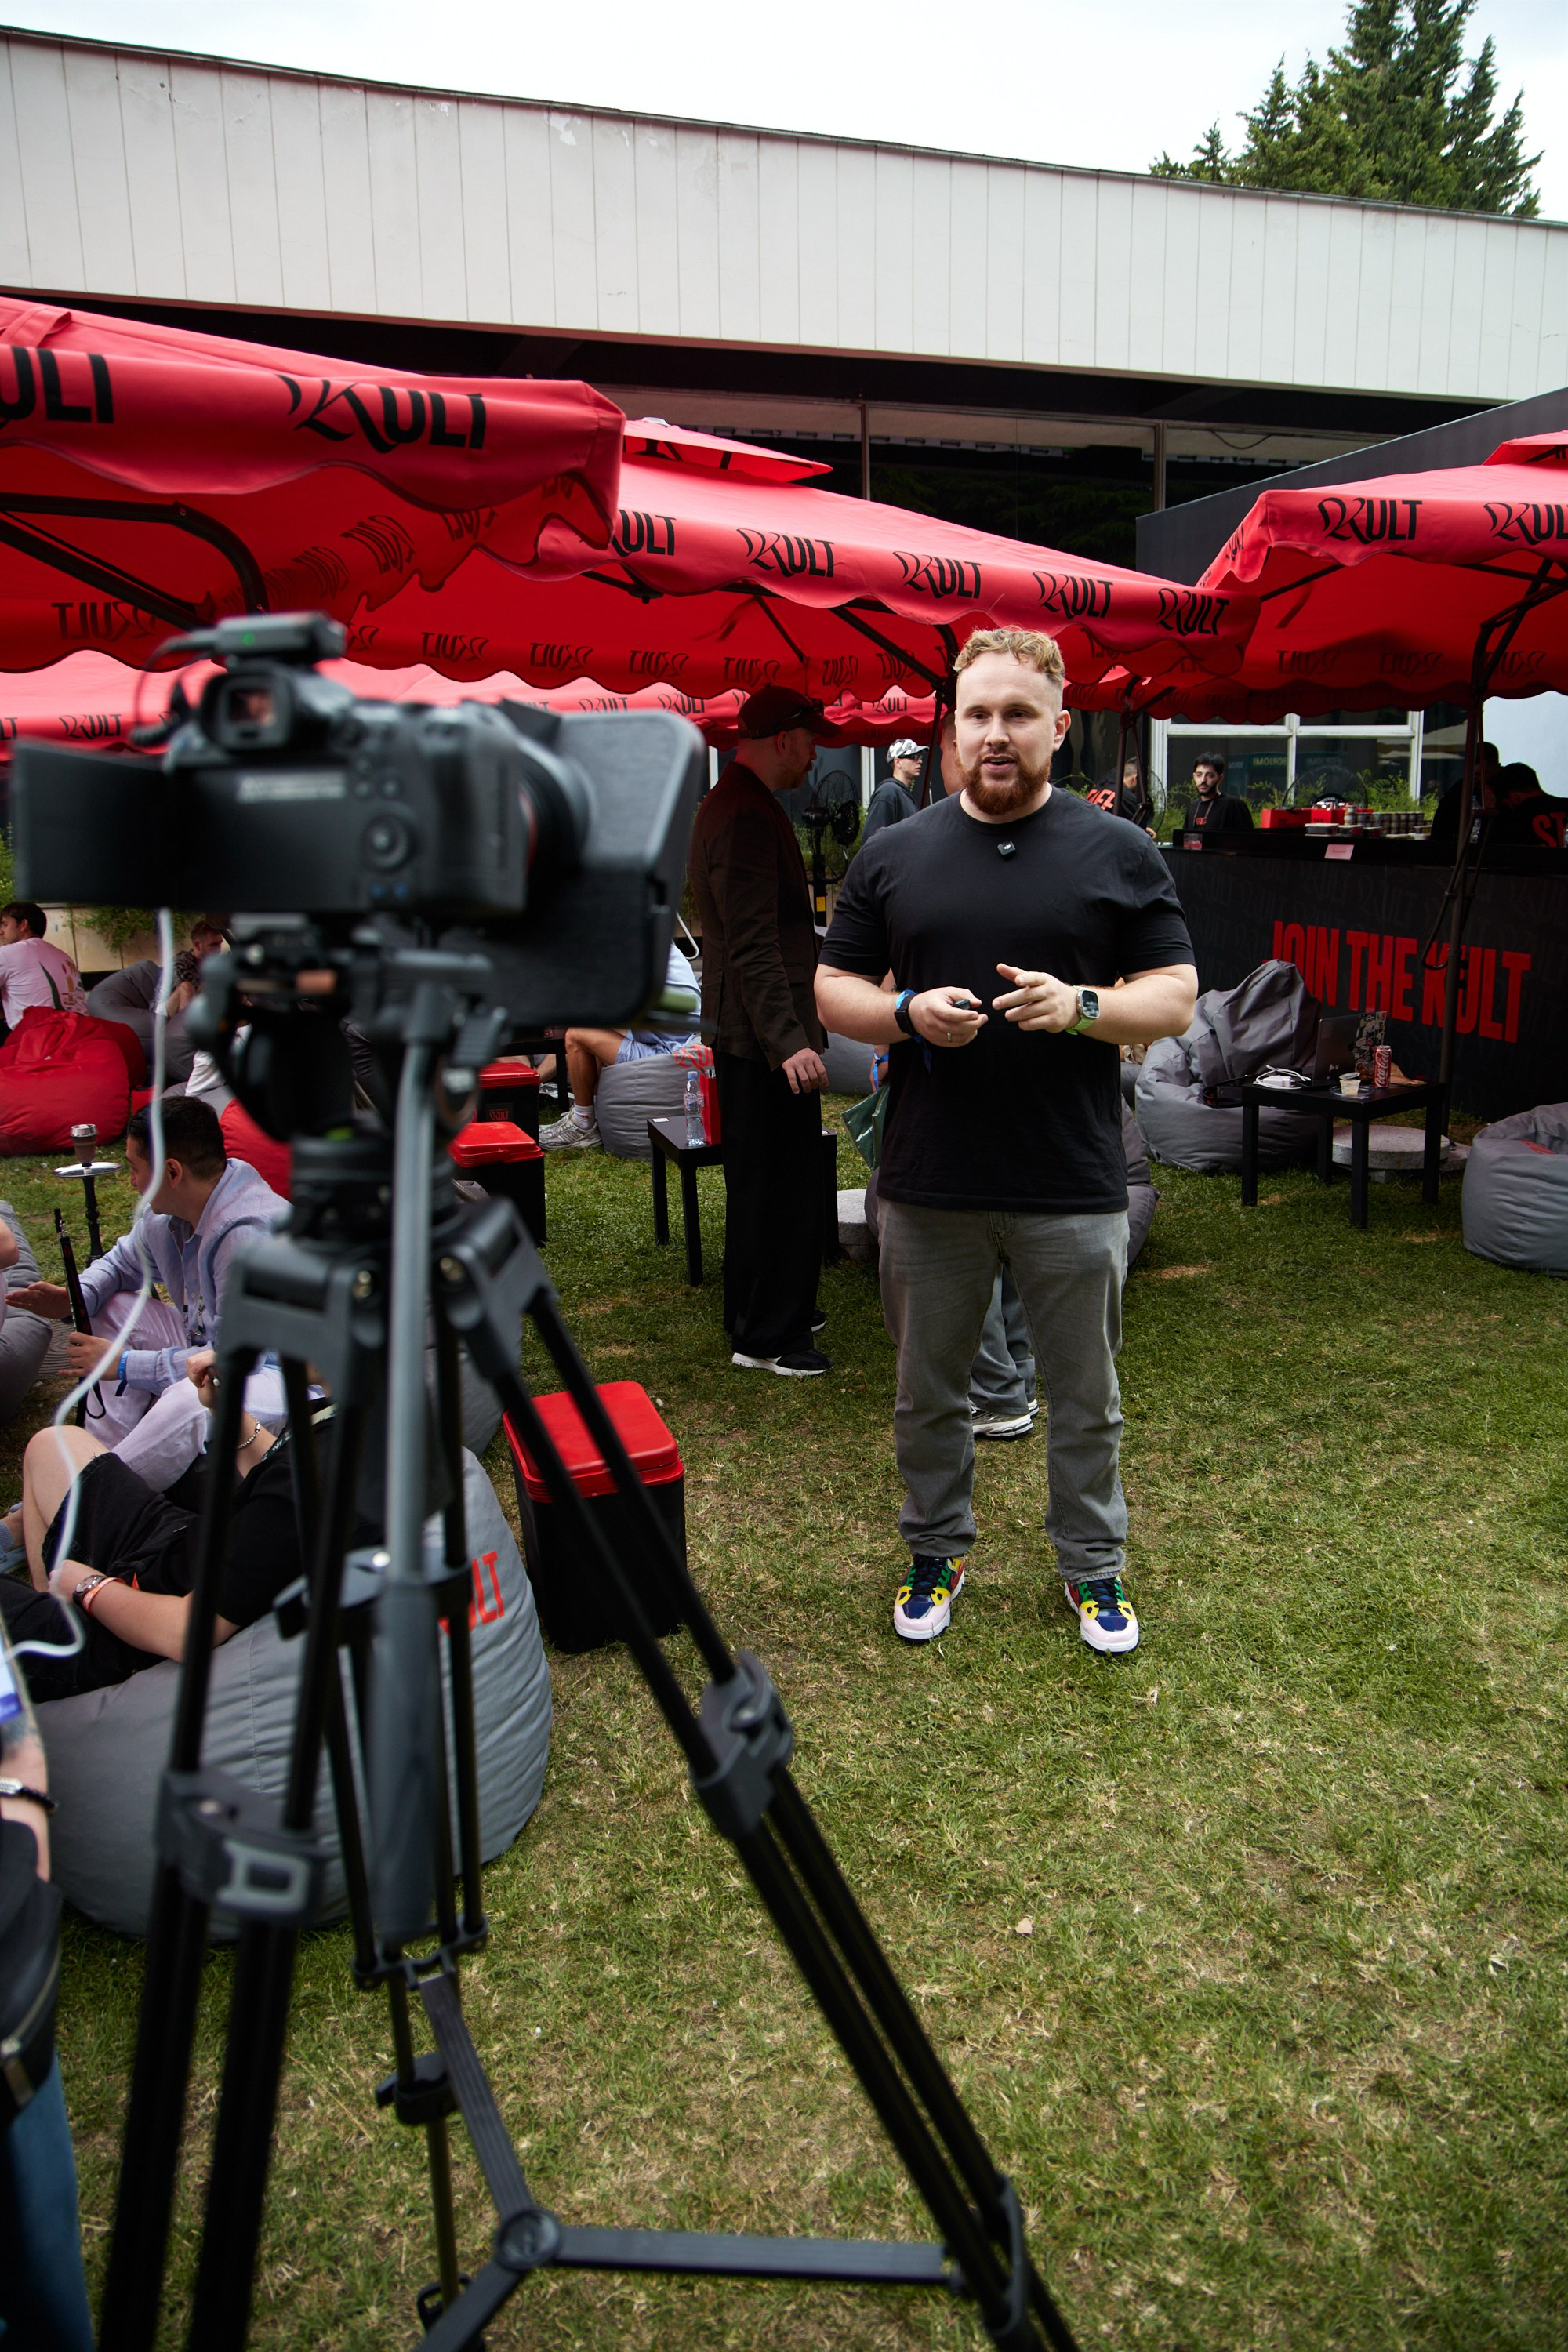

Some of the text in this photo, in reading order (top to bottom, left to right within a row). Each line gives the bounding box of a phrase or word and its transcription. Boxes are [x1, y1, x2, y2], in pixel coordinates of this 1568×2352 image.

[1317, 497, 1423, 545] KULT
[736, 528, 835, 578] KULT
[892, 551, 982, 599] KULT
[1032, 570, 1113, 619] KULT
[1156, 587, 1230, 636] KULT
[59, 714, 122, 740] KULT
[1345, 930, 1417, 1022] THE
